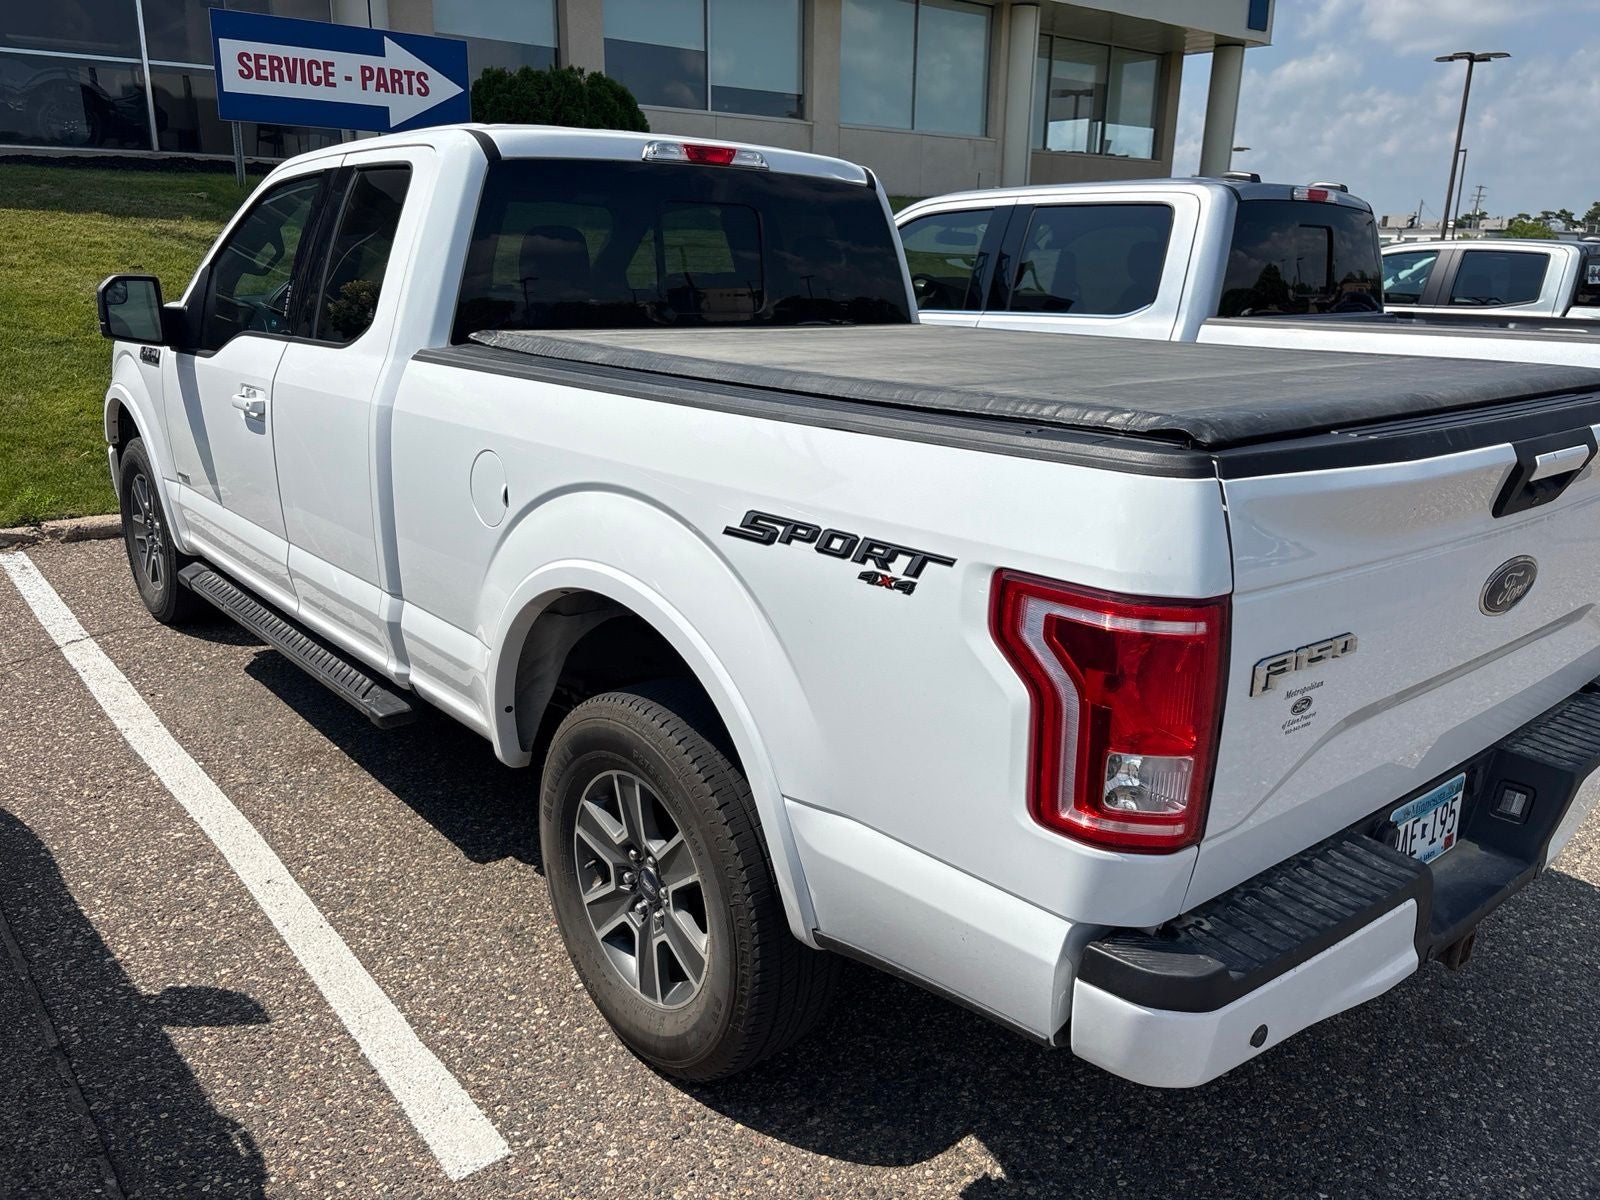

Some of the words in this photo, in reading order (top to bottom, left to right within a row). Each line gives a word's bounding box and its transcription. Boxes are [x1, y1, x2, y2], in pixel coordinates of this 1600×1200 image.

[237, 51, 337, 88] SERVICE
[360, 64, 430, 97] PARTS
[722, 509, 959, 580] SPORT
[1428, 796, 1459, 846] 195
